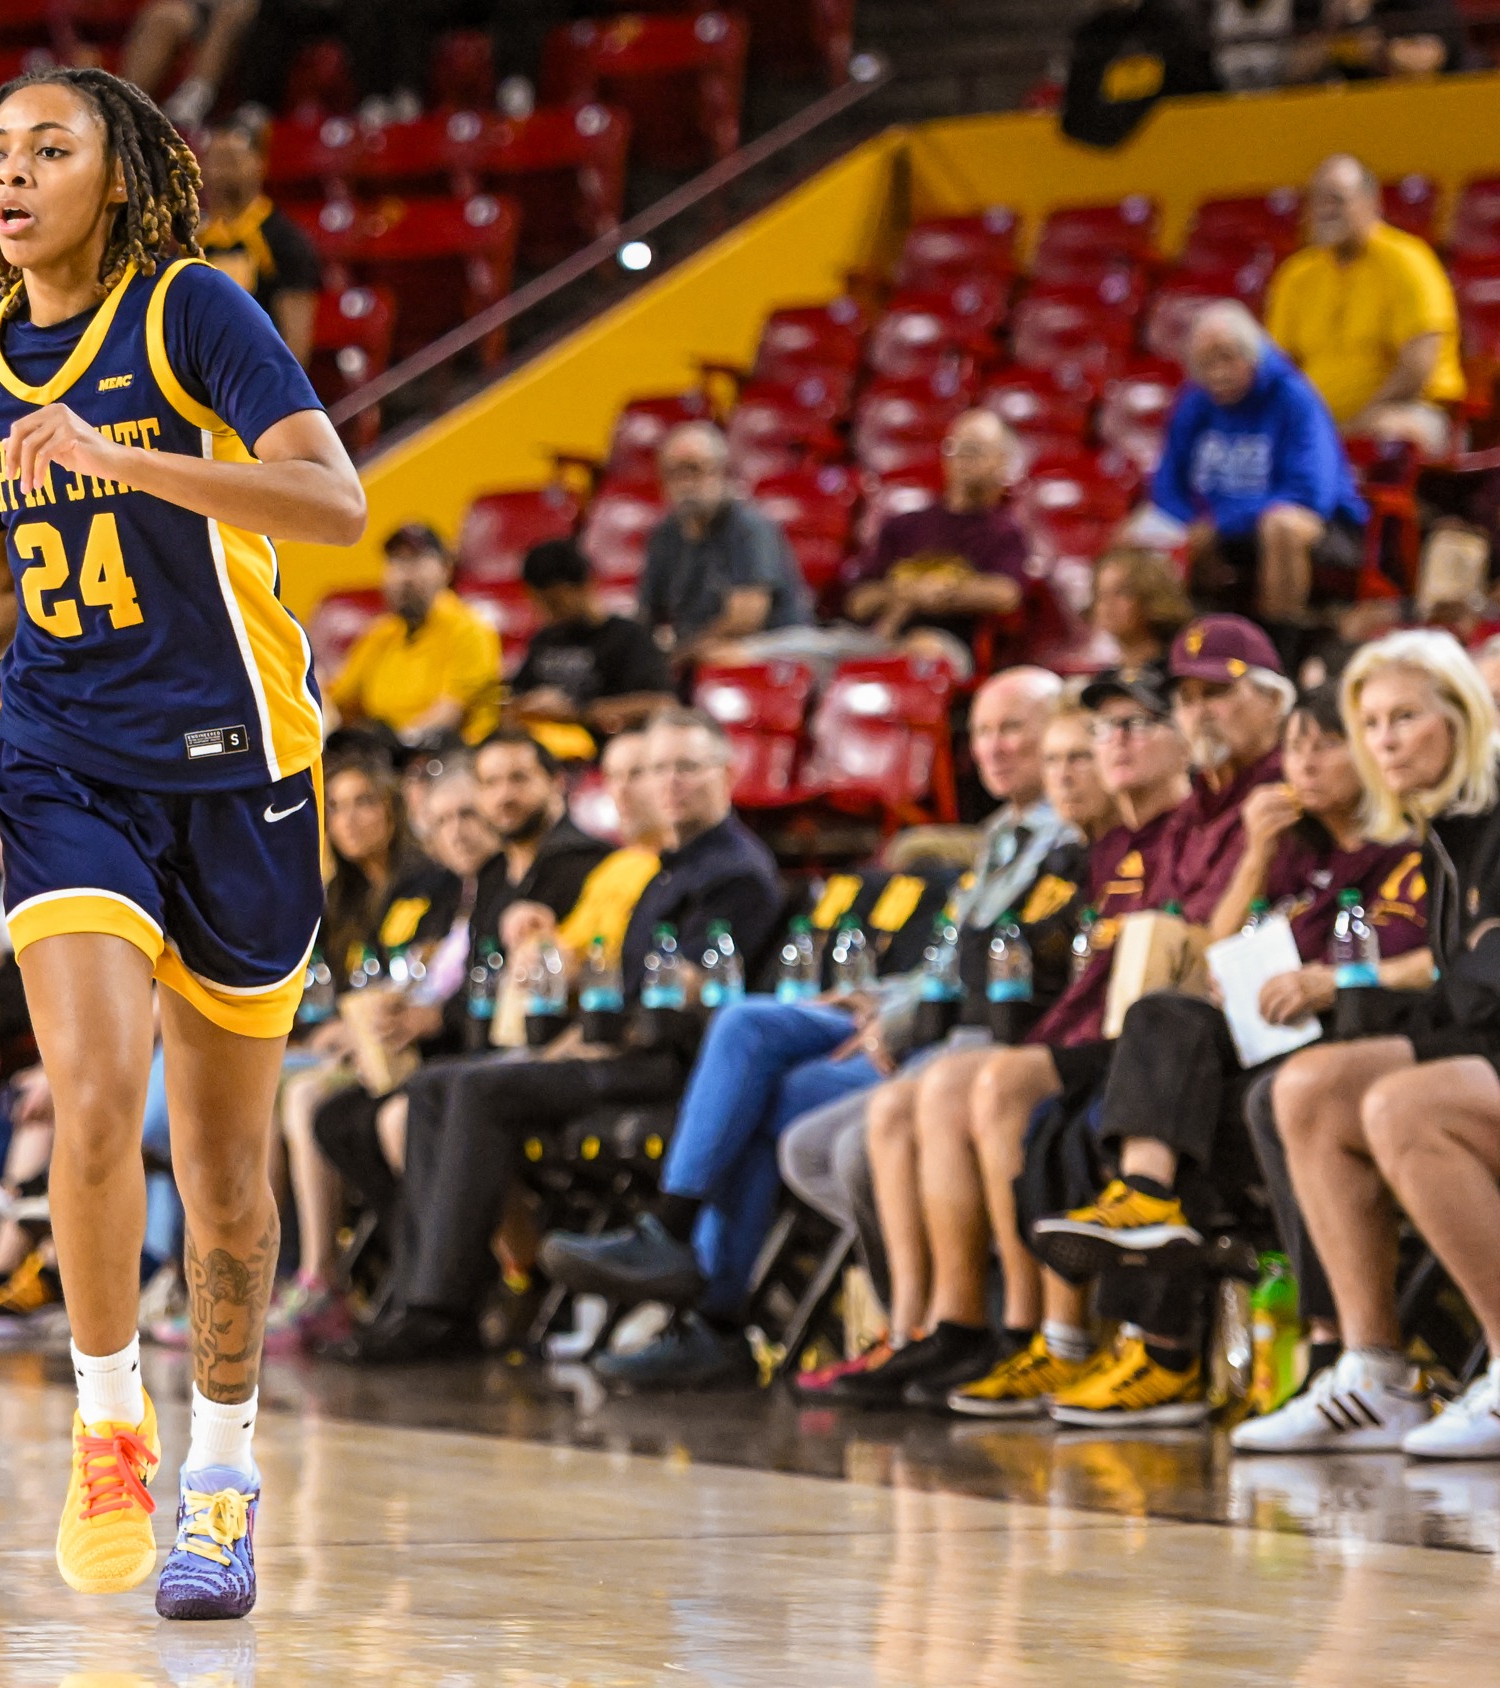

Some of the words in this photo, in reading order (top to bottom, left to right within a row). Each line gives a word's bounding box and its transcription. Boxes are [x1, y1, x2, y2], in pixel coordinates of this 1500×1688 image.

[98, 373, 133, 392] MEAC
[66, 417, 161, 502] STE
[13, 512, 145, 638] 24
[230, 733, 240, 746] S
